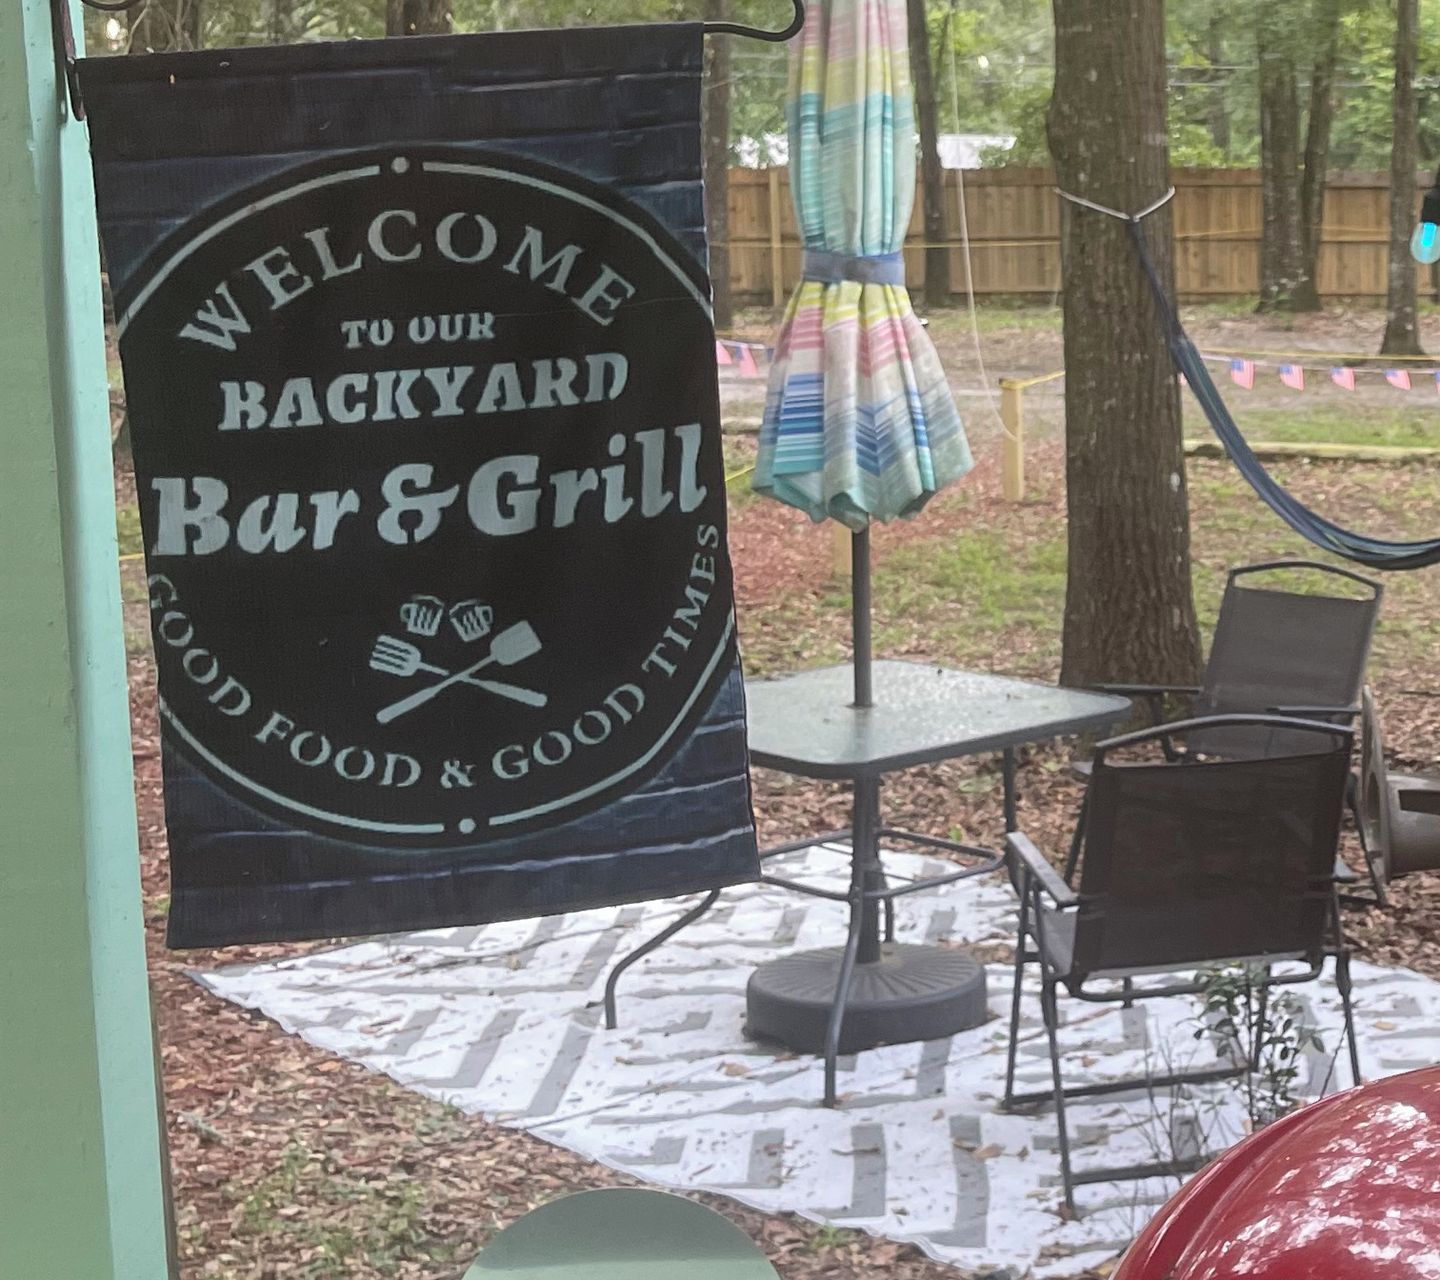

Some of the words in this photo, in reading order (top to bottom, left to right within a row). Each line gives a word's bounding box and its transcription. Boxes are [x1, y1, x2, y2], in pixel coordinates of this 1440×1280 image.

[179, 208, 637, 352] WELCOME
[341, 318, 394, 348] TO
[408, 311, 497, 344] OUR
[217, 352, 630, 431] BACKYARD
[148, 573, 252, 717] GOOD
[254, 712, 422, 789] FOOD
[439, 759, 477, 789] &
[492, 682, 647, 781] GOOD
[641, 524, 720, 678] TIMES
